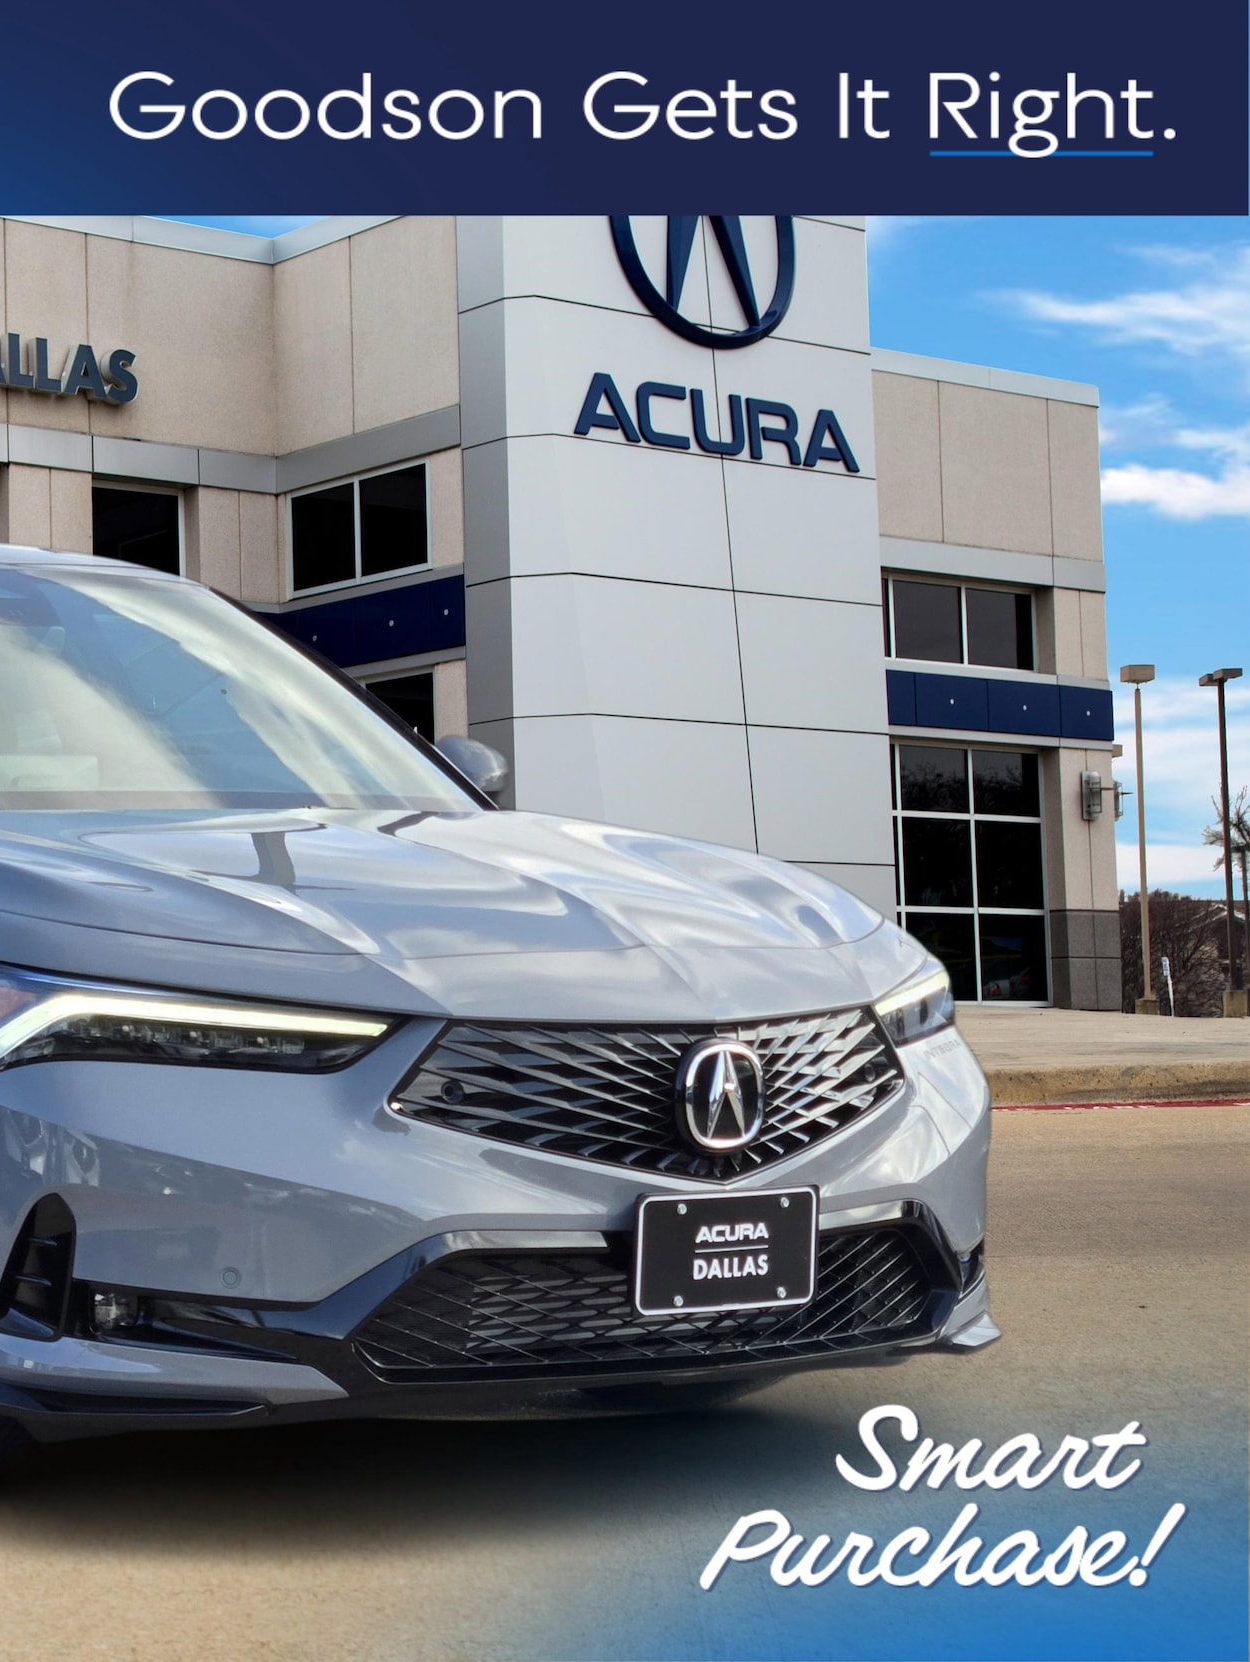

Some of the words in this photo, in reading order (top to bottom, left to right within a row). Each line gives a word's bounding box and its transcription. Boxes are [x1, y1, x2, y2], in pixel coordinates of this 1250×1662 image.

[573, 372, 861, 473] ACURA
[694, 1222, 769, 1243] ACURA
[692, 1253, 769, 1281] DALLAS
